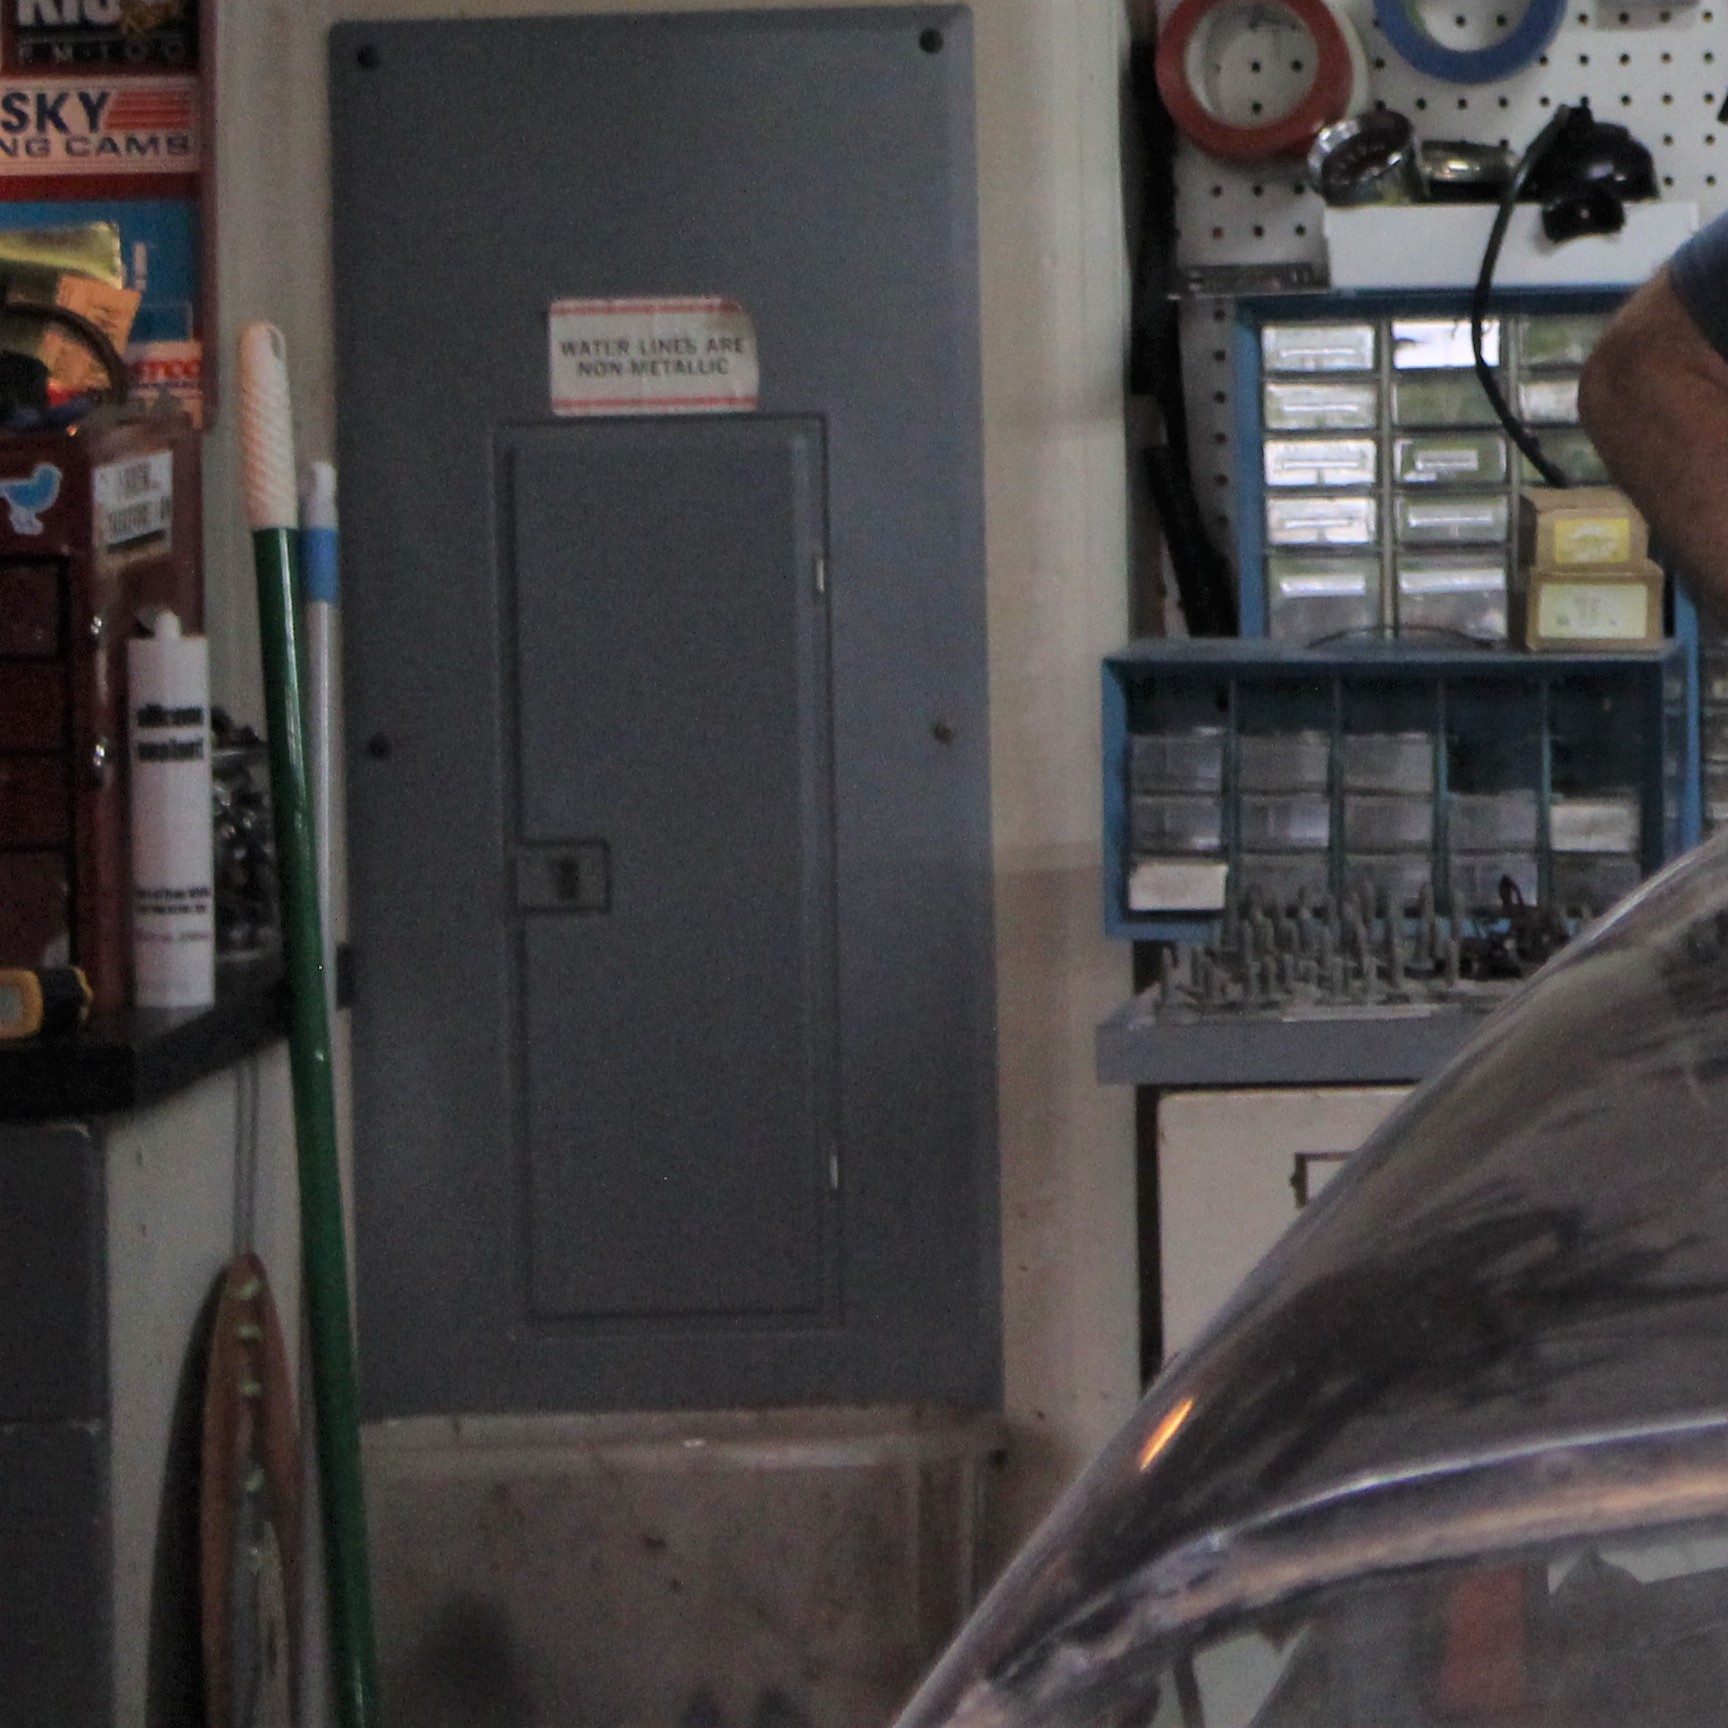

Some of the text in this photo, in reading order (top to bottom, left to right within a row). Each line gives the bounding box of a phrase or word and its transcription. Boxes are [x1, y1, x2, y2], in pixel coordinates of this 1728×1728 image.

[1, 91, 110, 134] SKY
[65, 135, 190, 157] CAMS
[560, 336, 744, 356] WATER LINES ARE
[577, 358, 730, 377] NON METALLIC
